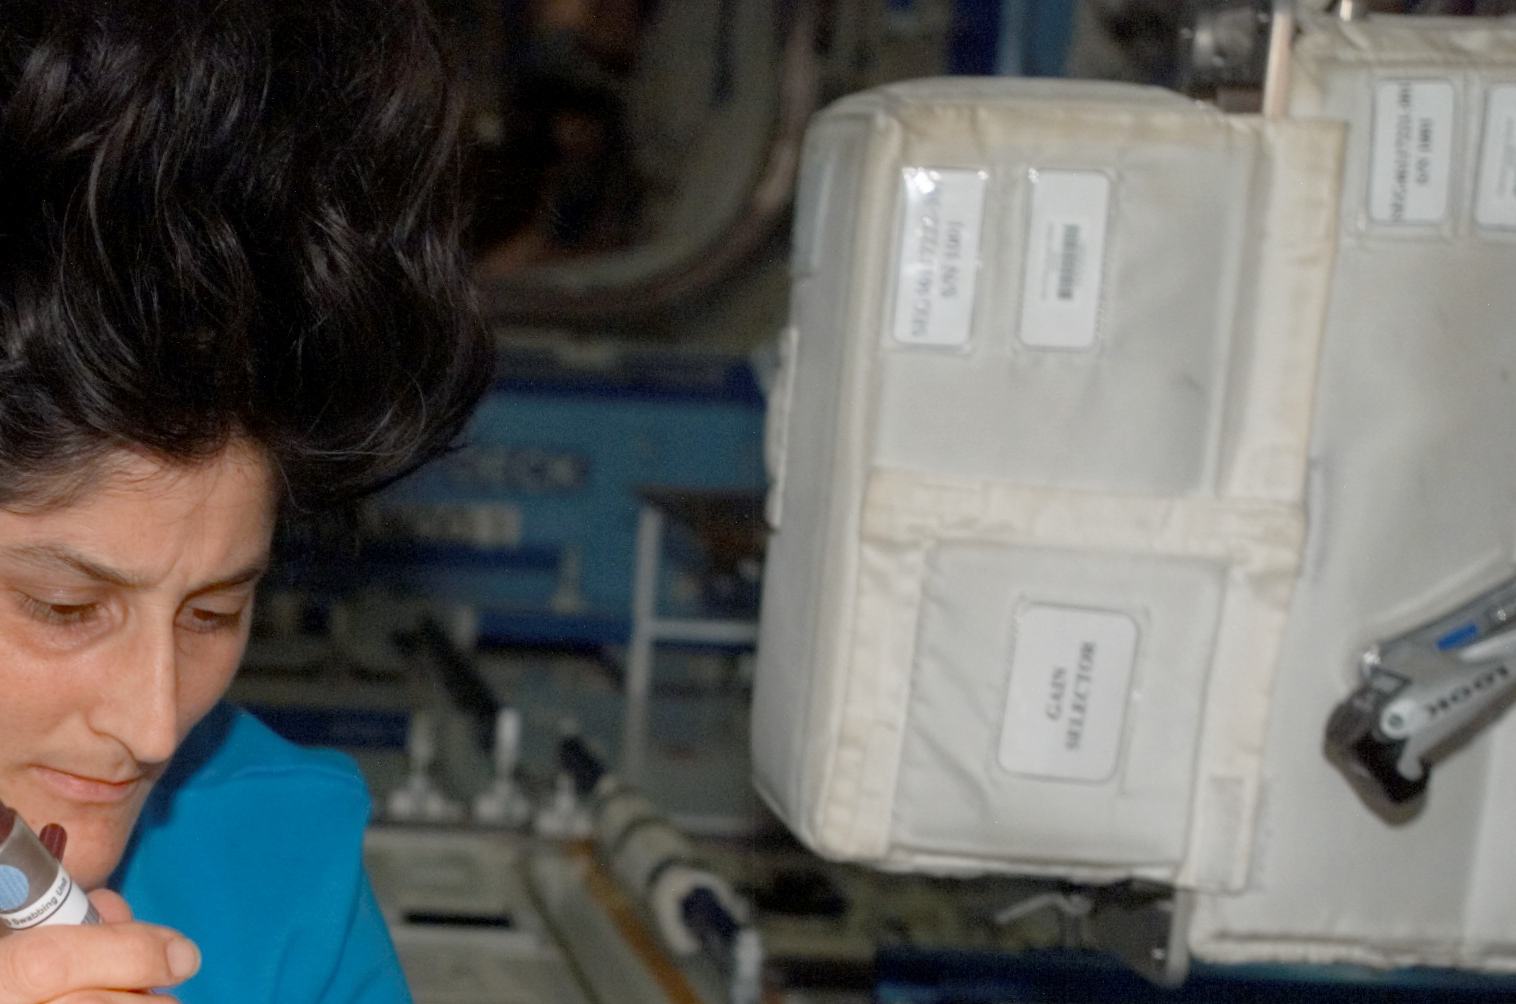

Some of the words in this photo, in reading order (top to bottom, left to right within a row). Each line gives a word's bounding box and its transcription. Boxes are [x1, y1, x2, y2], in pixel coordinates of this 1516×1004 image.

[1045, 667, 1067, 722] GAIN
[1065, 641, 1096, 751] SELECTOR
[11, 896, 59, 926] Swabbing
